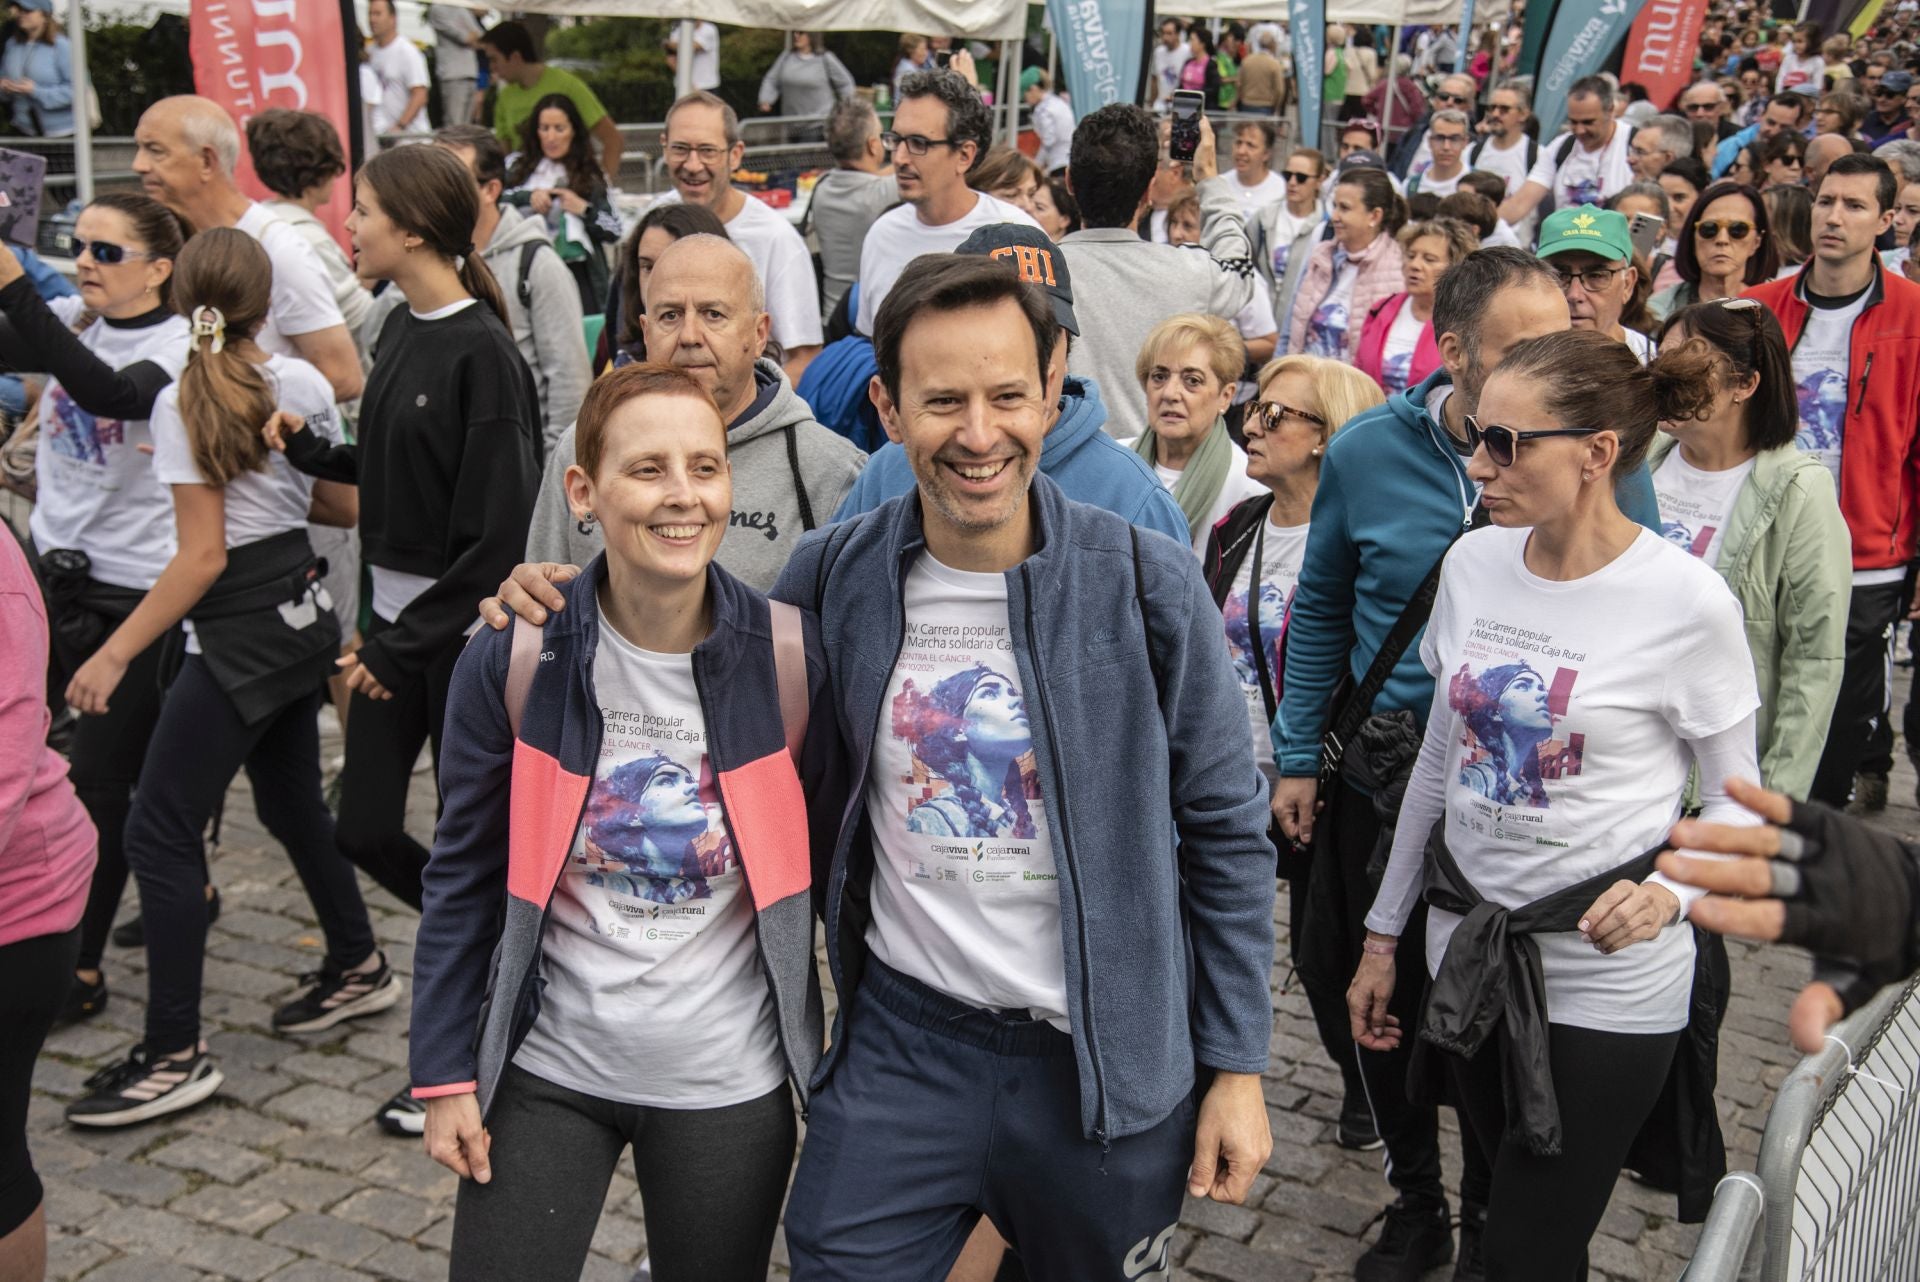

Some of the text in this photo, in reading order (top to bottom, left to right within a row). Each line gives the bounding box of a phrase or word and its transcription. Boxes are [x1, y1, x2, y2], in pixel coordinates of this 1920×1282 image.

[1638, 0, 1682, 75] mu
[1545, 16, 1603, 91] cajaviva
[730, 510, 778, 541] nes
[920, 624, 959, 636] Carrera
[962, 624, 1006, 638] popular
[1473, 617, 1552, 644] XIV Carrera popular
[908, 636, 946, 648] Marcha
[950, 636, 994, 650] solidaria
[1468, 628, 1586, 662] y Marcha solidaria Caja Rural
[930, 654, 938, 662] EL
[601, 708, 684, 728] Carrera popular
[628, 724, 672, 740] solidaria
[676, 729, 700, 744] Caja
[1504, 812, 1544, 824] cajarural
[930, 844, 1030, 856] cajaviva cajarural
[608, 900, 705, 916] cajaviva cajarural
